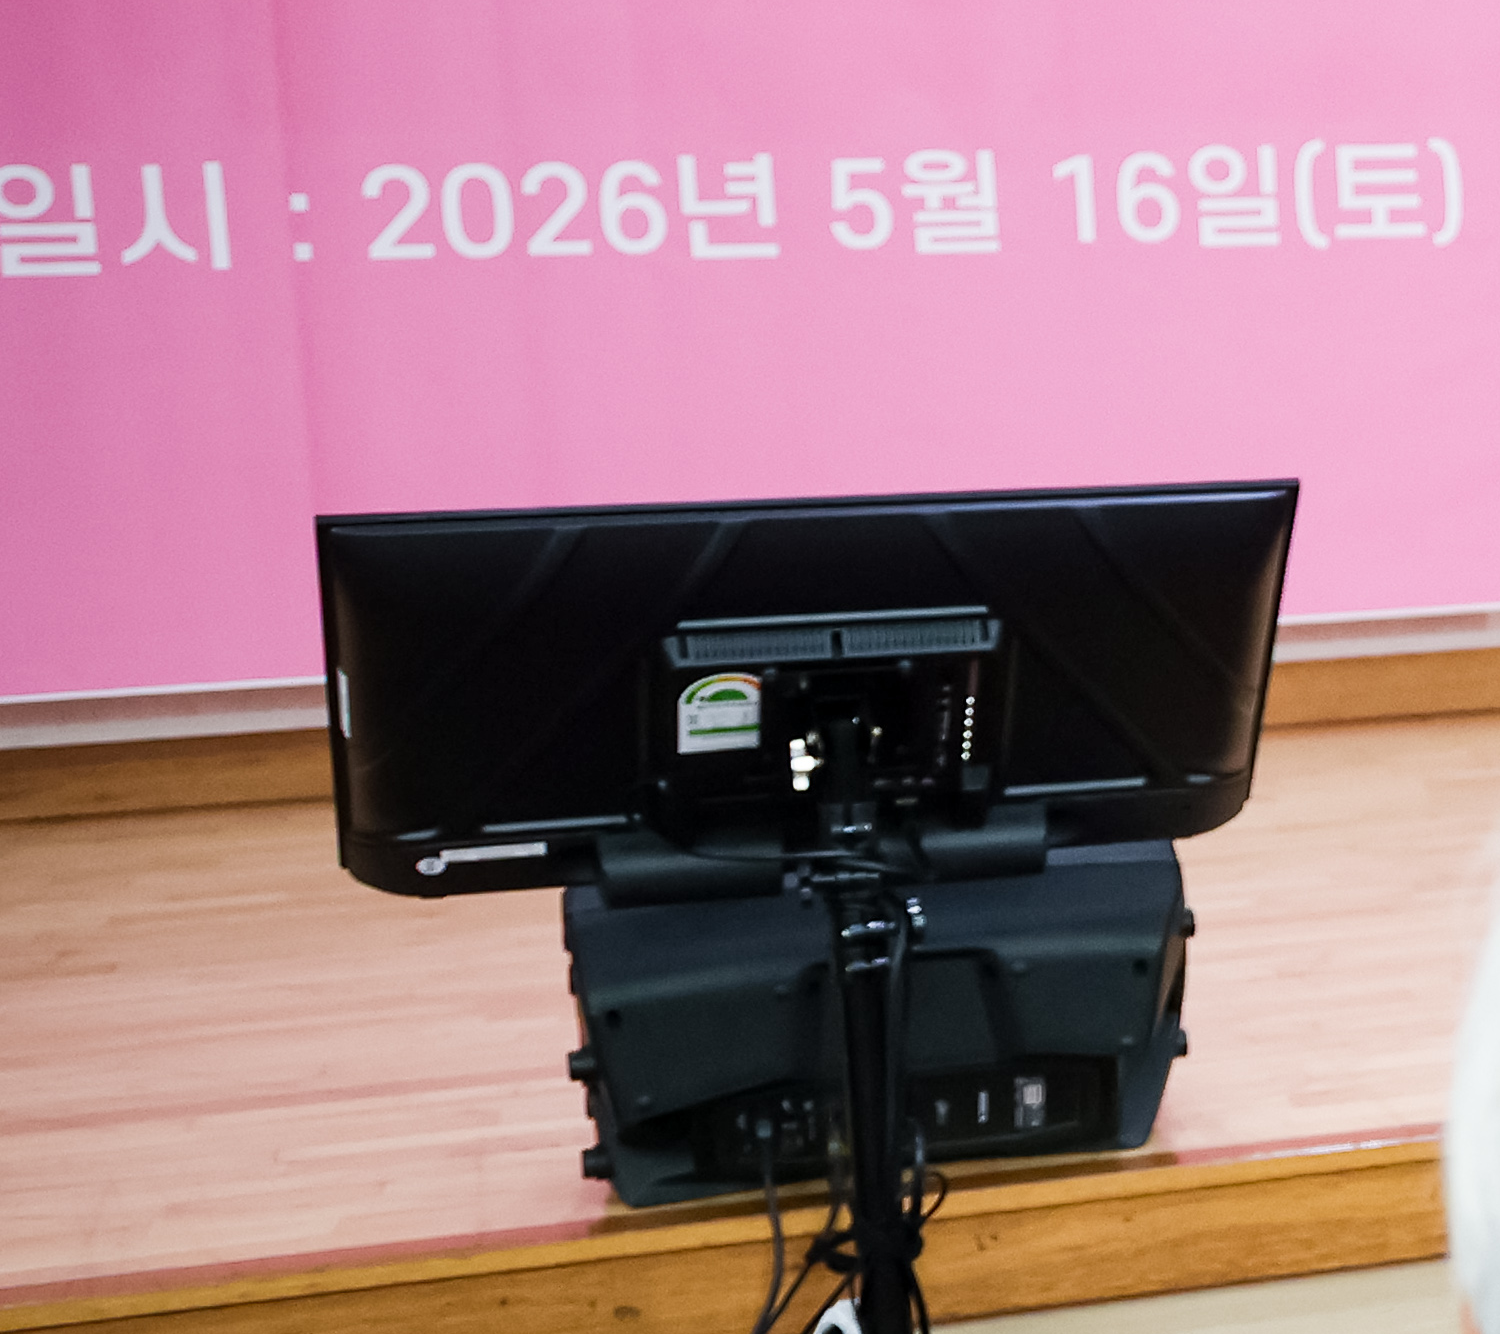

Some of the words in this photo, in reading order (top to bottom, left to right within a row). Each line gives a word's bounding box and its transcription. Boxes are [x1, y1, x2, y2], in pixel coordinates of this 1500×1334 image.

[0, 160, 232, 278] 일시
[360, 151, 781, 261] 2026년
[828, 147, 1002, 255] 5월
[1051, 137, 1465, 251] 16일(토)
